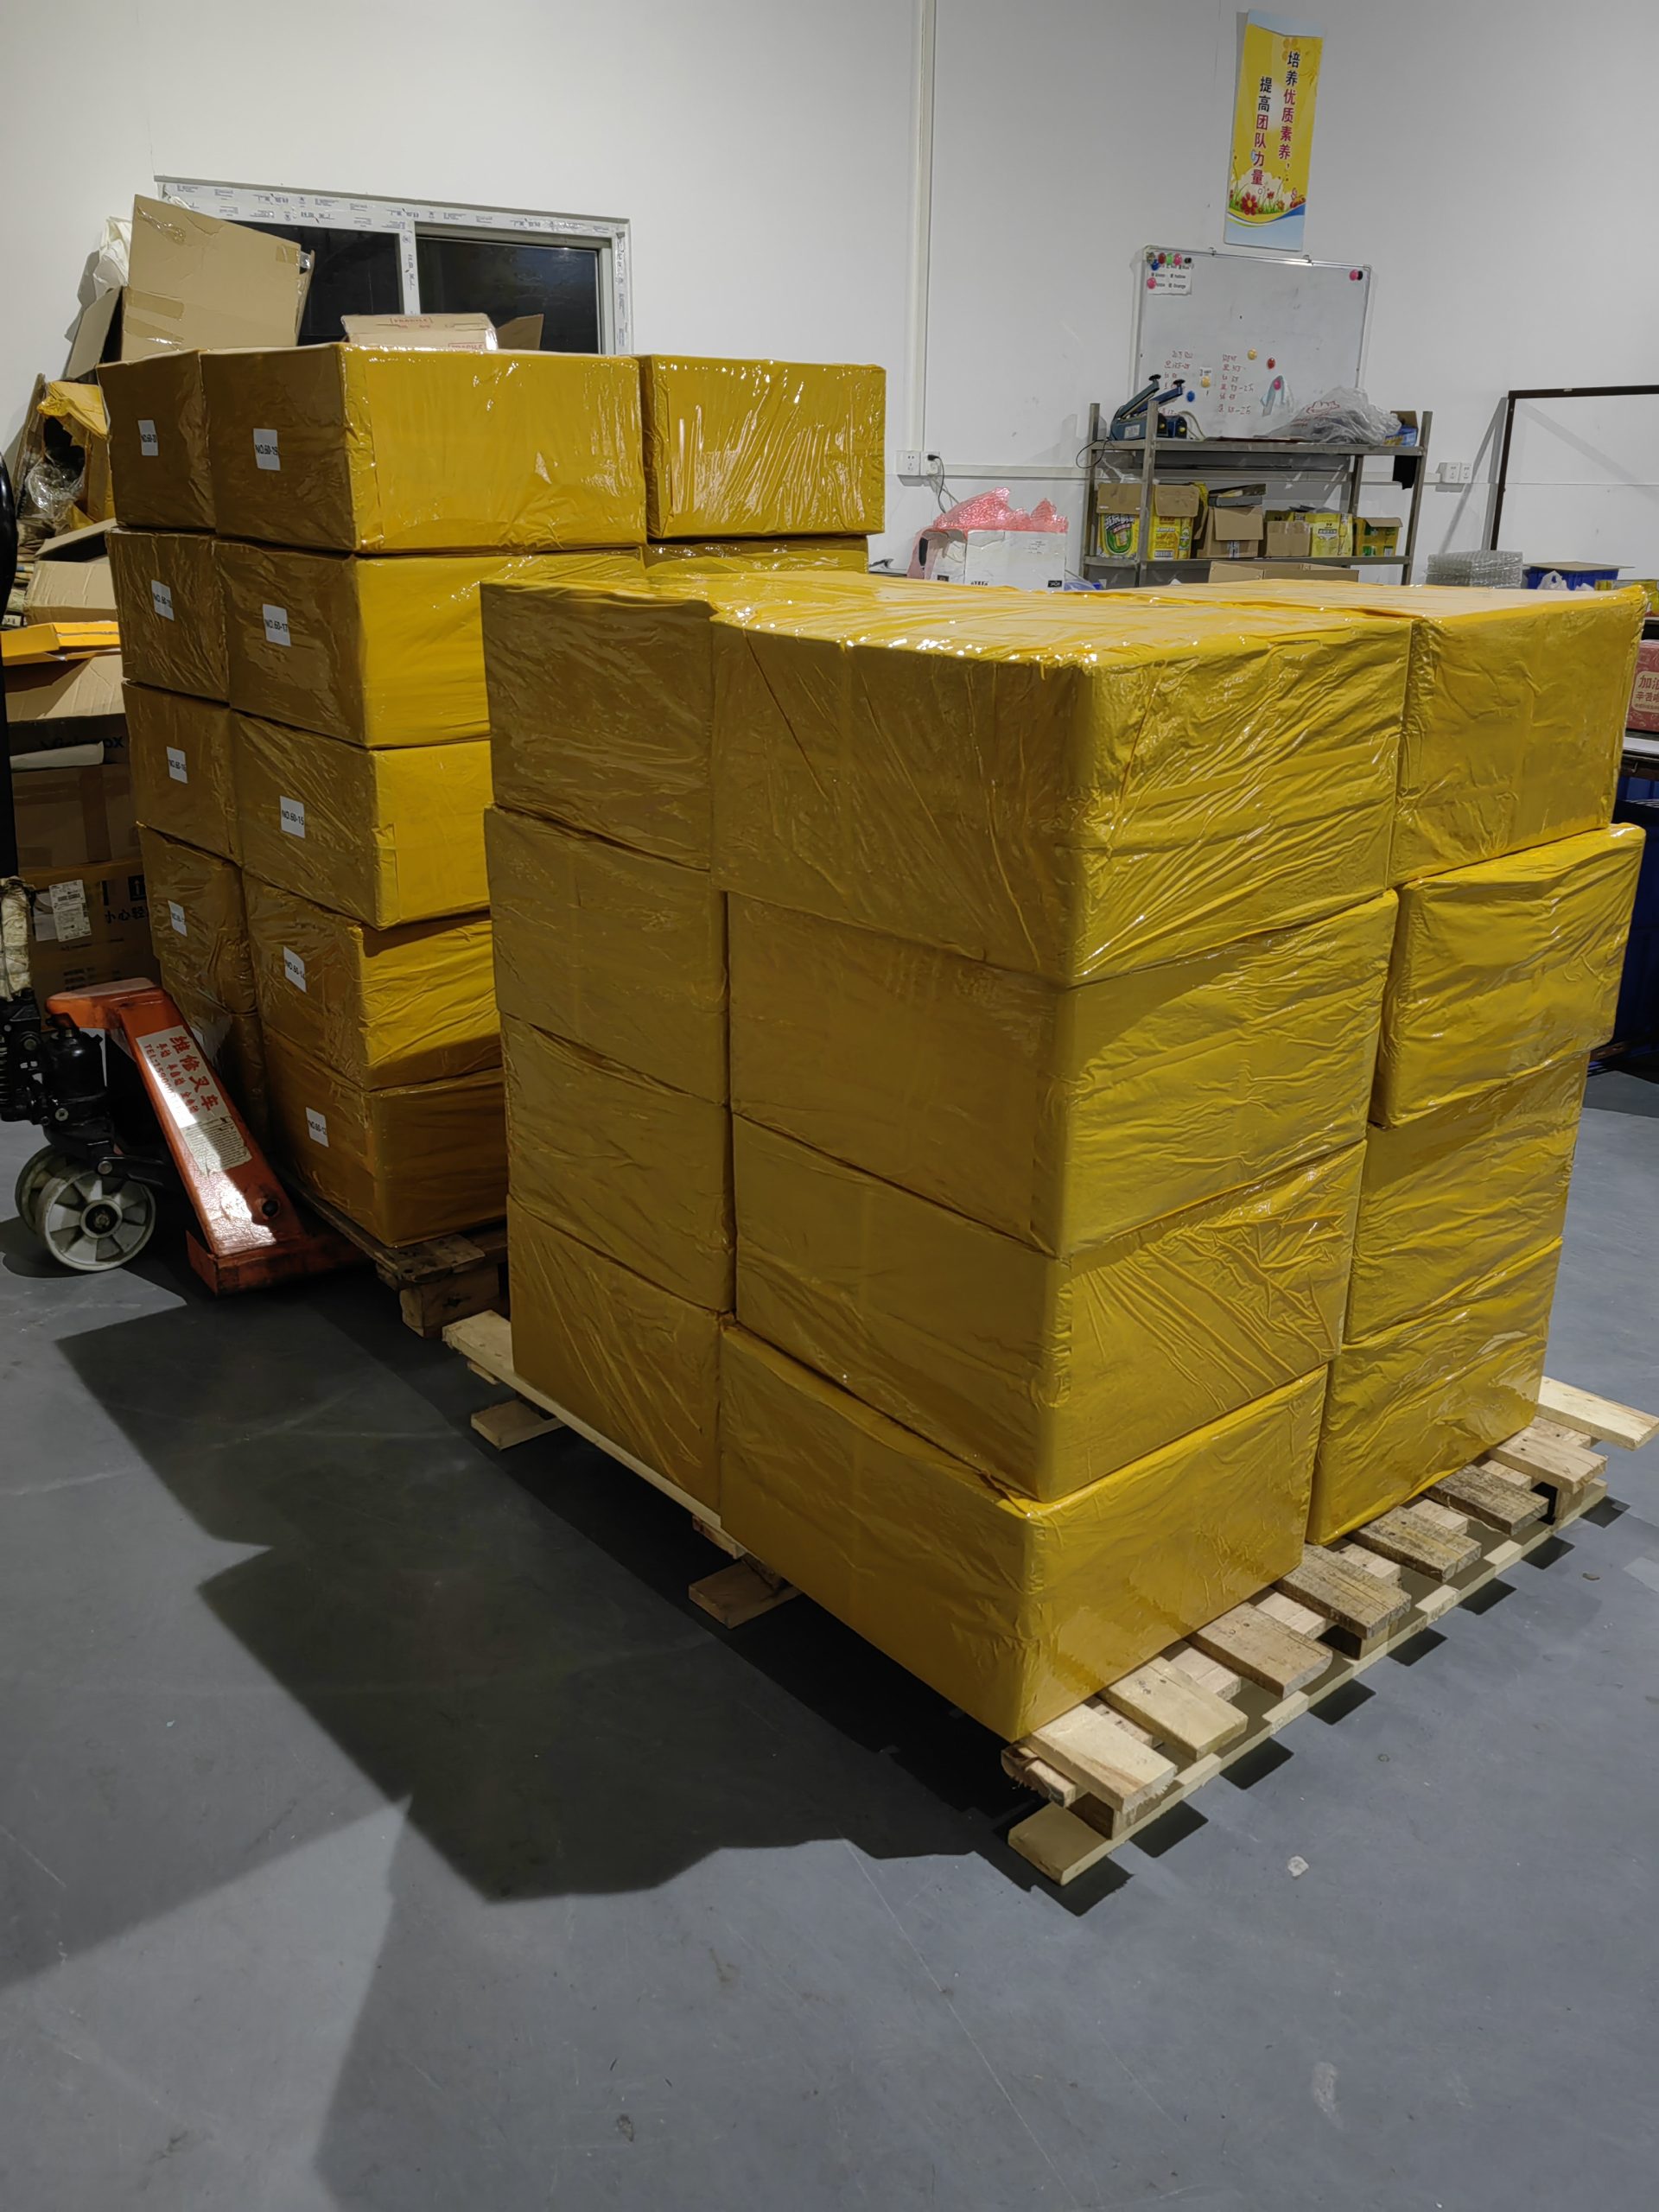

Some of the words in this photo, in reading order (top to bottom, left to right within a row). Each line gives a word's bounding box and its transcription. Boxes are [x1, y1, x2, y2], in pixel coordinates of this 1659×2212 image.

[1278, 50, 1300, 169] 培养优质素养，
[168, 1034, 220, 1112] 维修叉车
